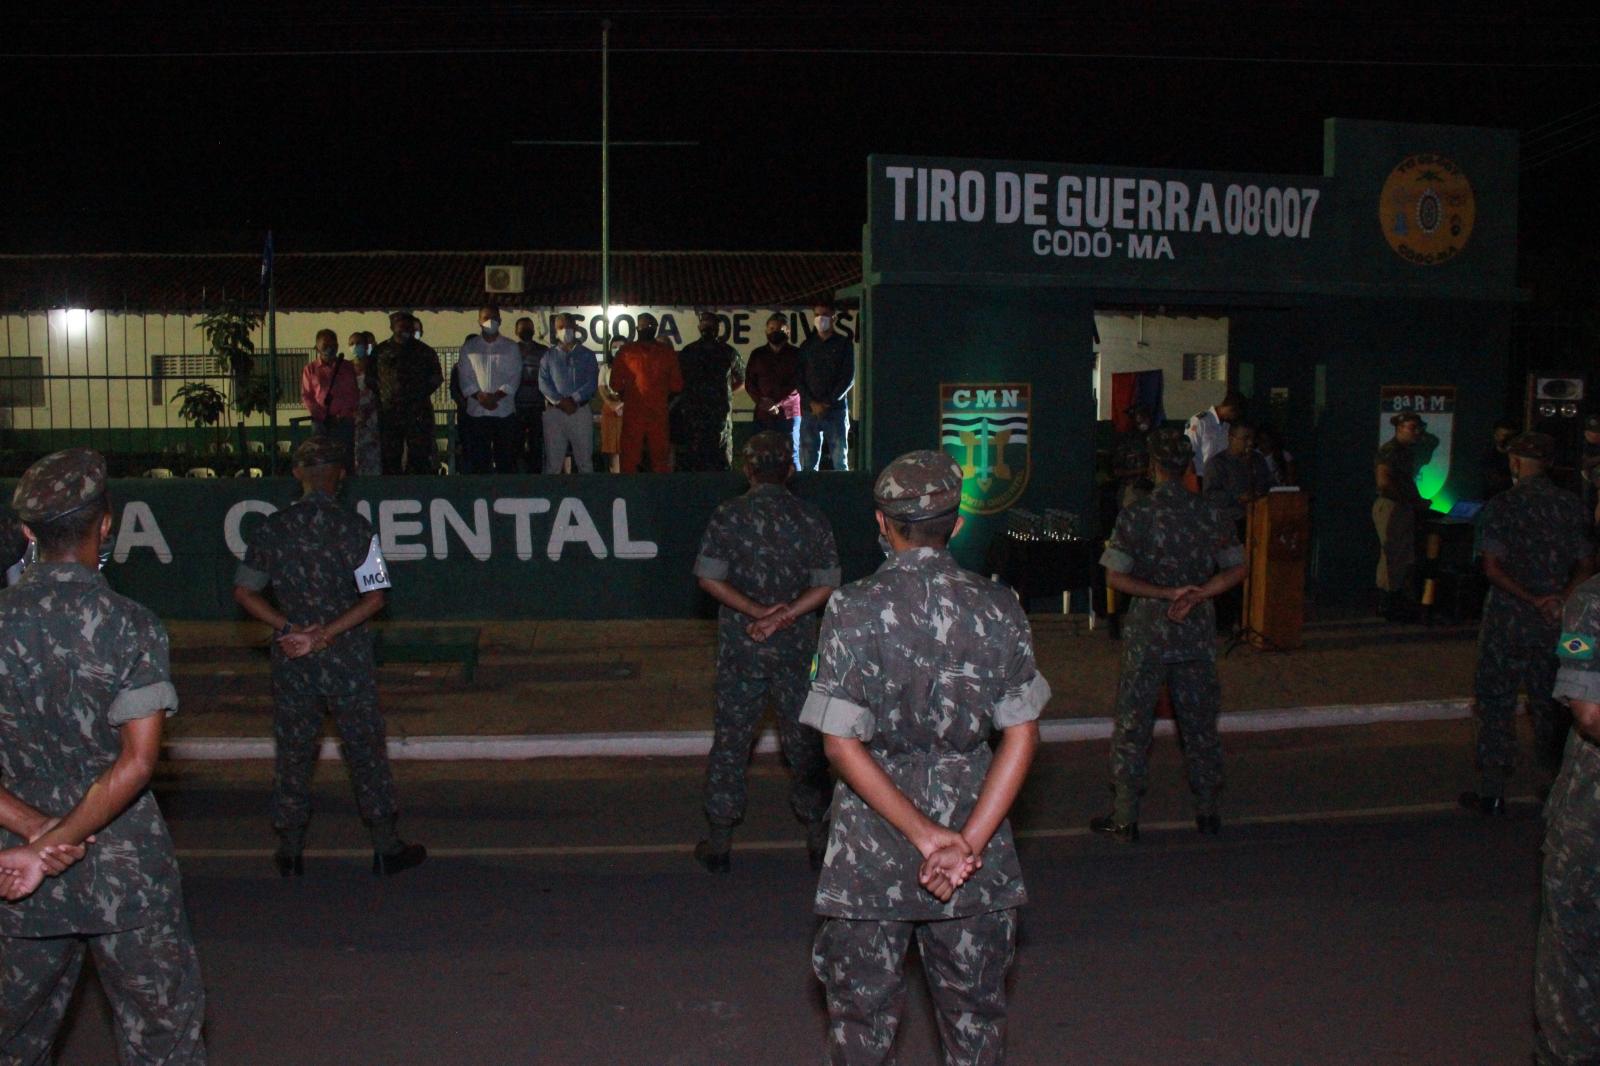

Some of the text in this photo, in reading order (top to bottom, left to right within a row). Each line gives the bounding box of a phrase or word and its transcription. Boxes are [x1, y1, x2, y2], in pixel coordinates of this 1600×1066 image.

[886, 166, 986, 223] TIRO
[995, 171, 1048, 225] DE
[1057, 175, 1222, 234] GUERRA
[223, 497, 659, 562] OENTAL
